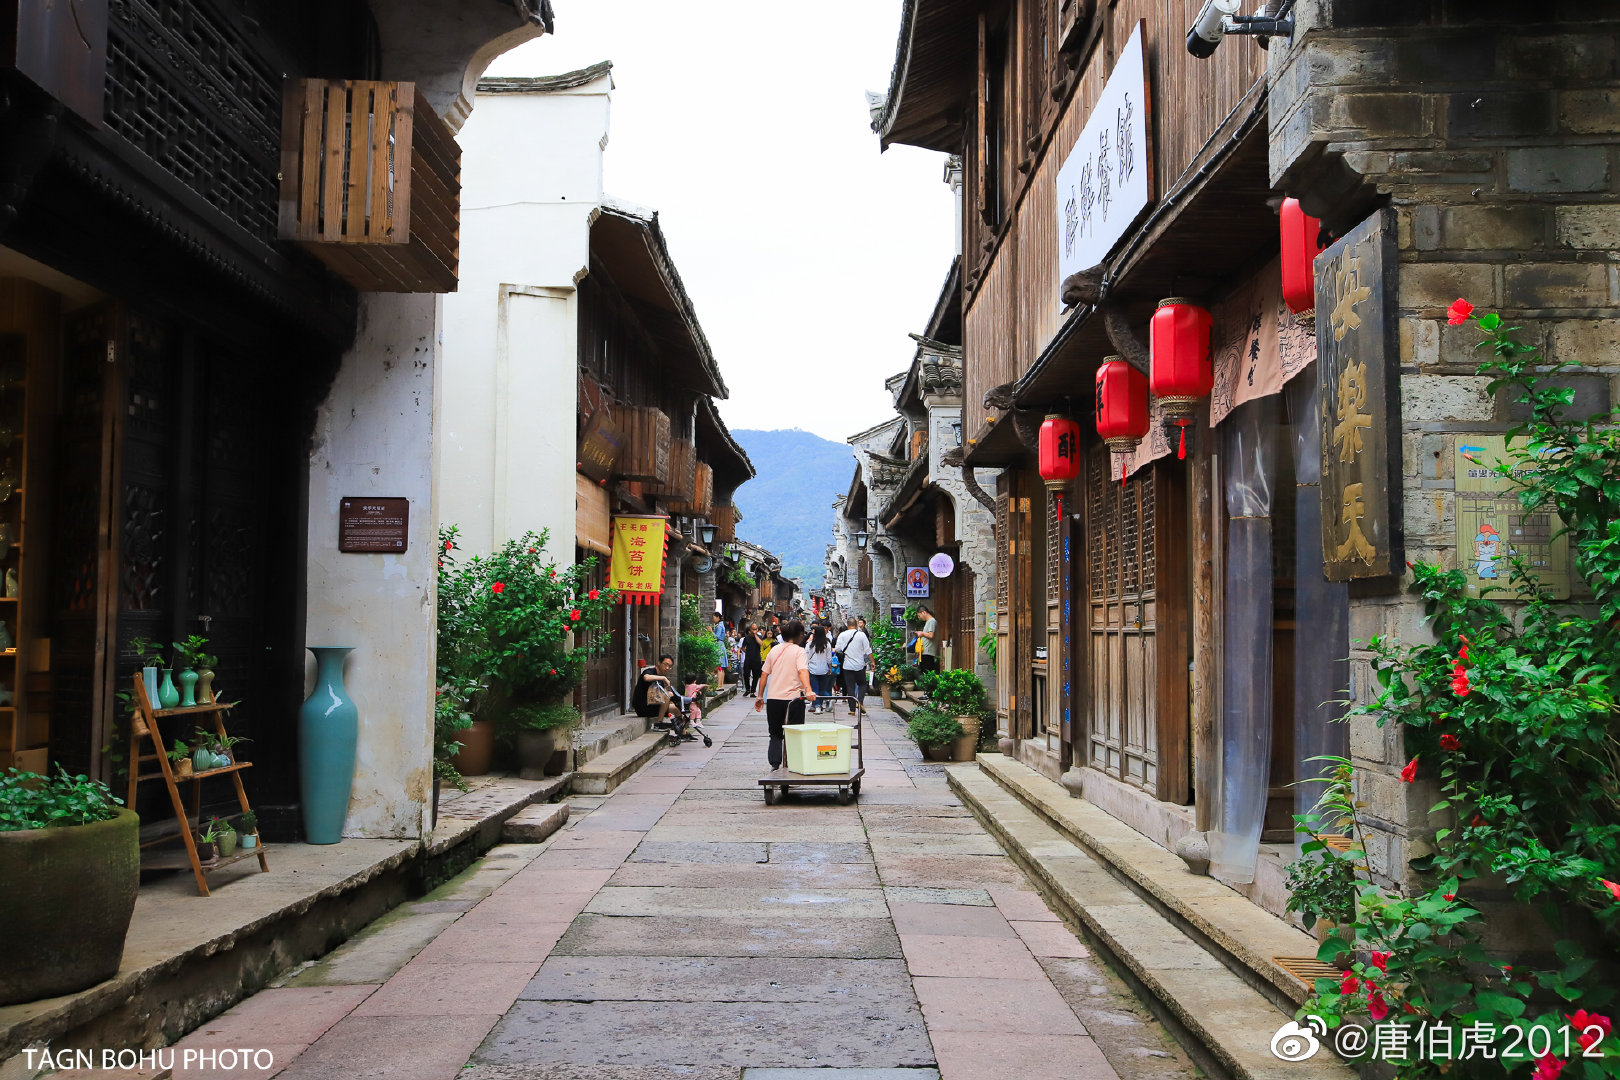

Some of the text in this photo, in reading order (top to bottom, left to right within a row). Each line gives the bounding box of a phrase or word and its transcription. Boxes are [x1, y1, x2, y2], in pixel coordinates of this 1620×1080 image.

[628, 536, 646, 577] 海苔饼
[617, 580, 653, 590] 百年老店
